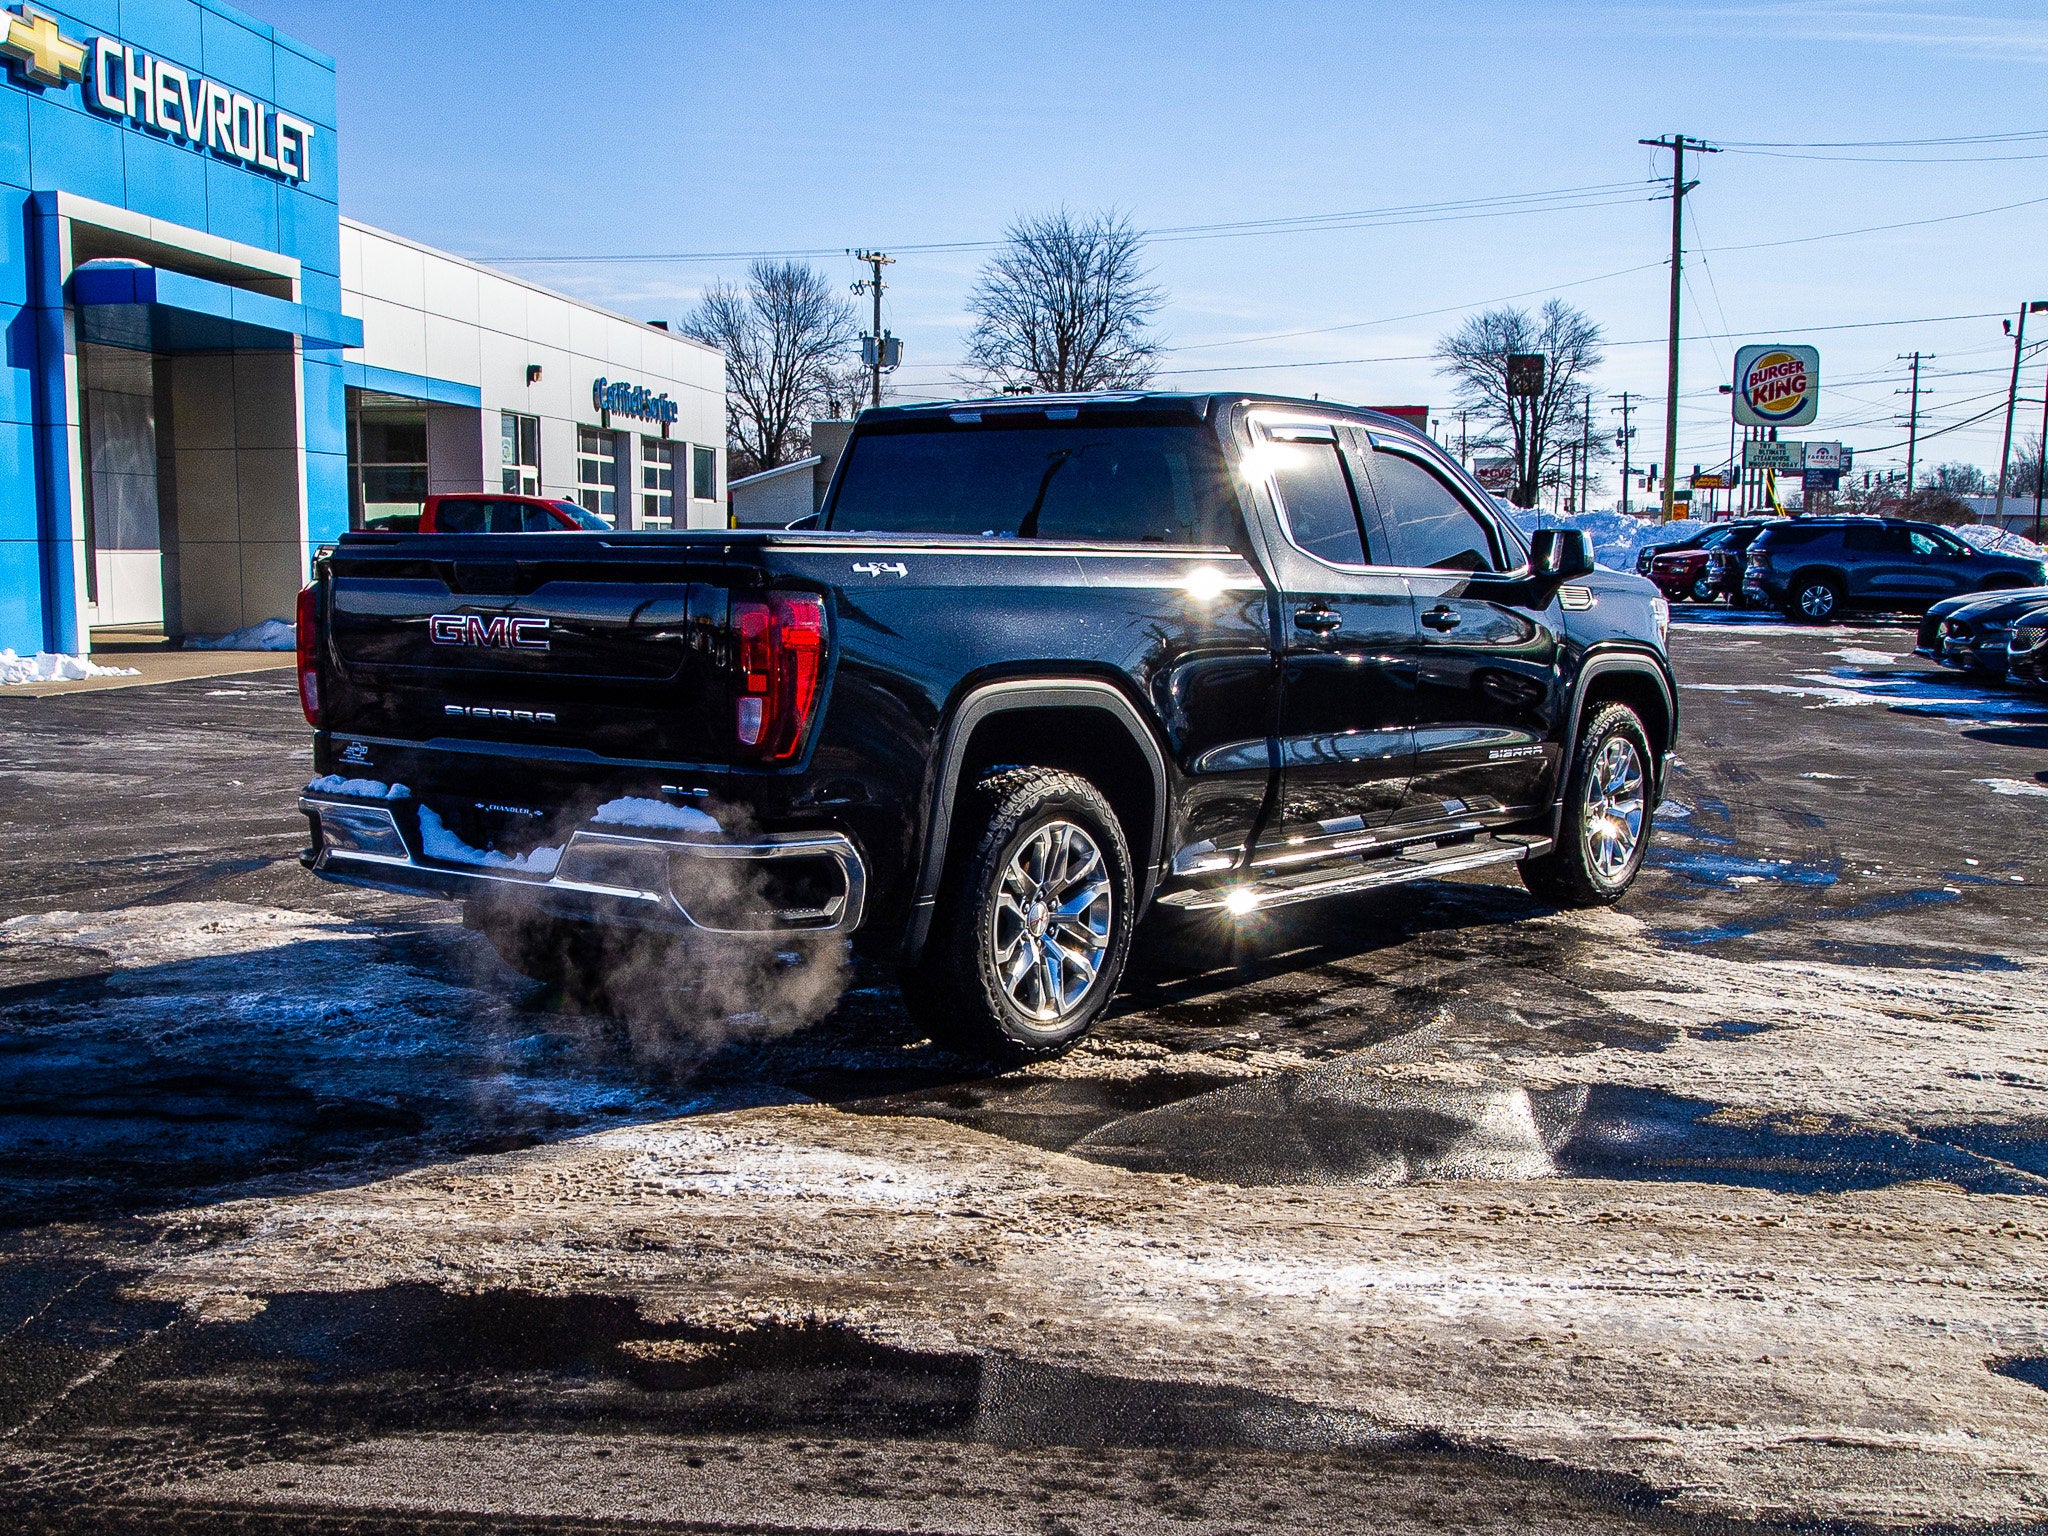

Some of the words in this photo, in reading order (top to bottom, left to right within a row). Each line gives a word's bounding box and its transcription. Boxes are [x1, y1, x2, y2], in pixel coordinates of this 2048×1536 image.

[96, 36, 314, 182] CHEVROLET
[1749, 361, 1804, 387] BURGER
[595, 377, 642, 417] Certified
[645, 389, 678, 423] Service
[1752, 375, 1807, 406] KING
[1490, 468, 1511, 477] CVS
[430, 614, 550, 650] GMC
[444, 705, 557, 723] SIERRA
[1488, 746, 1543, 759] SIERRA
[489, 804, 530, 815] CHANDLER
